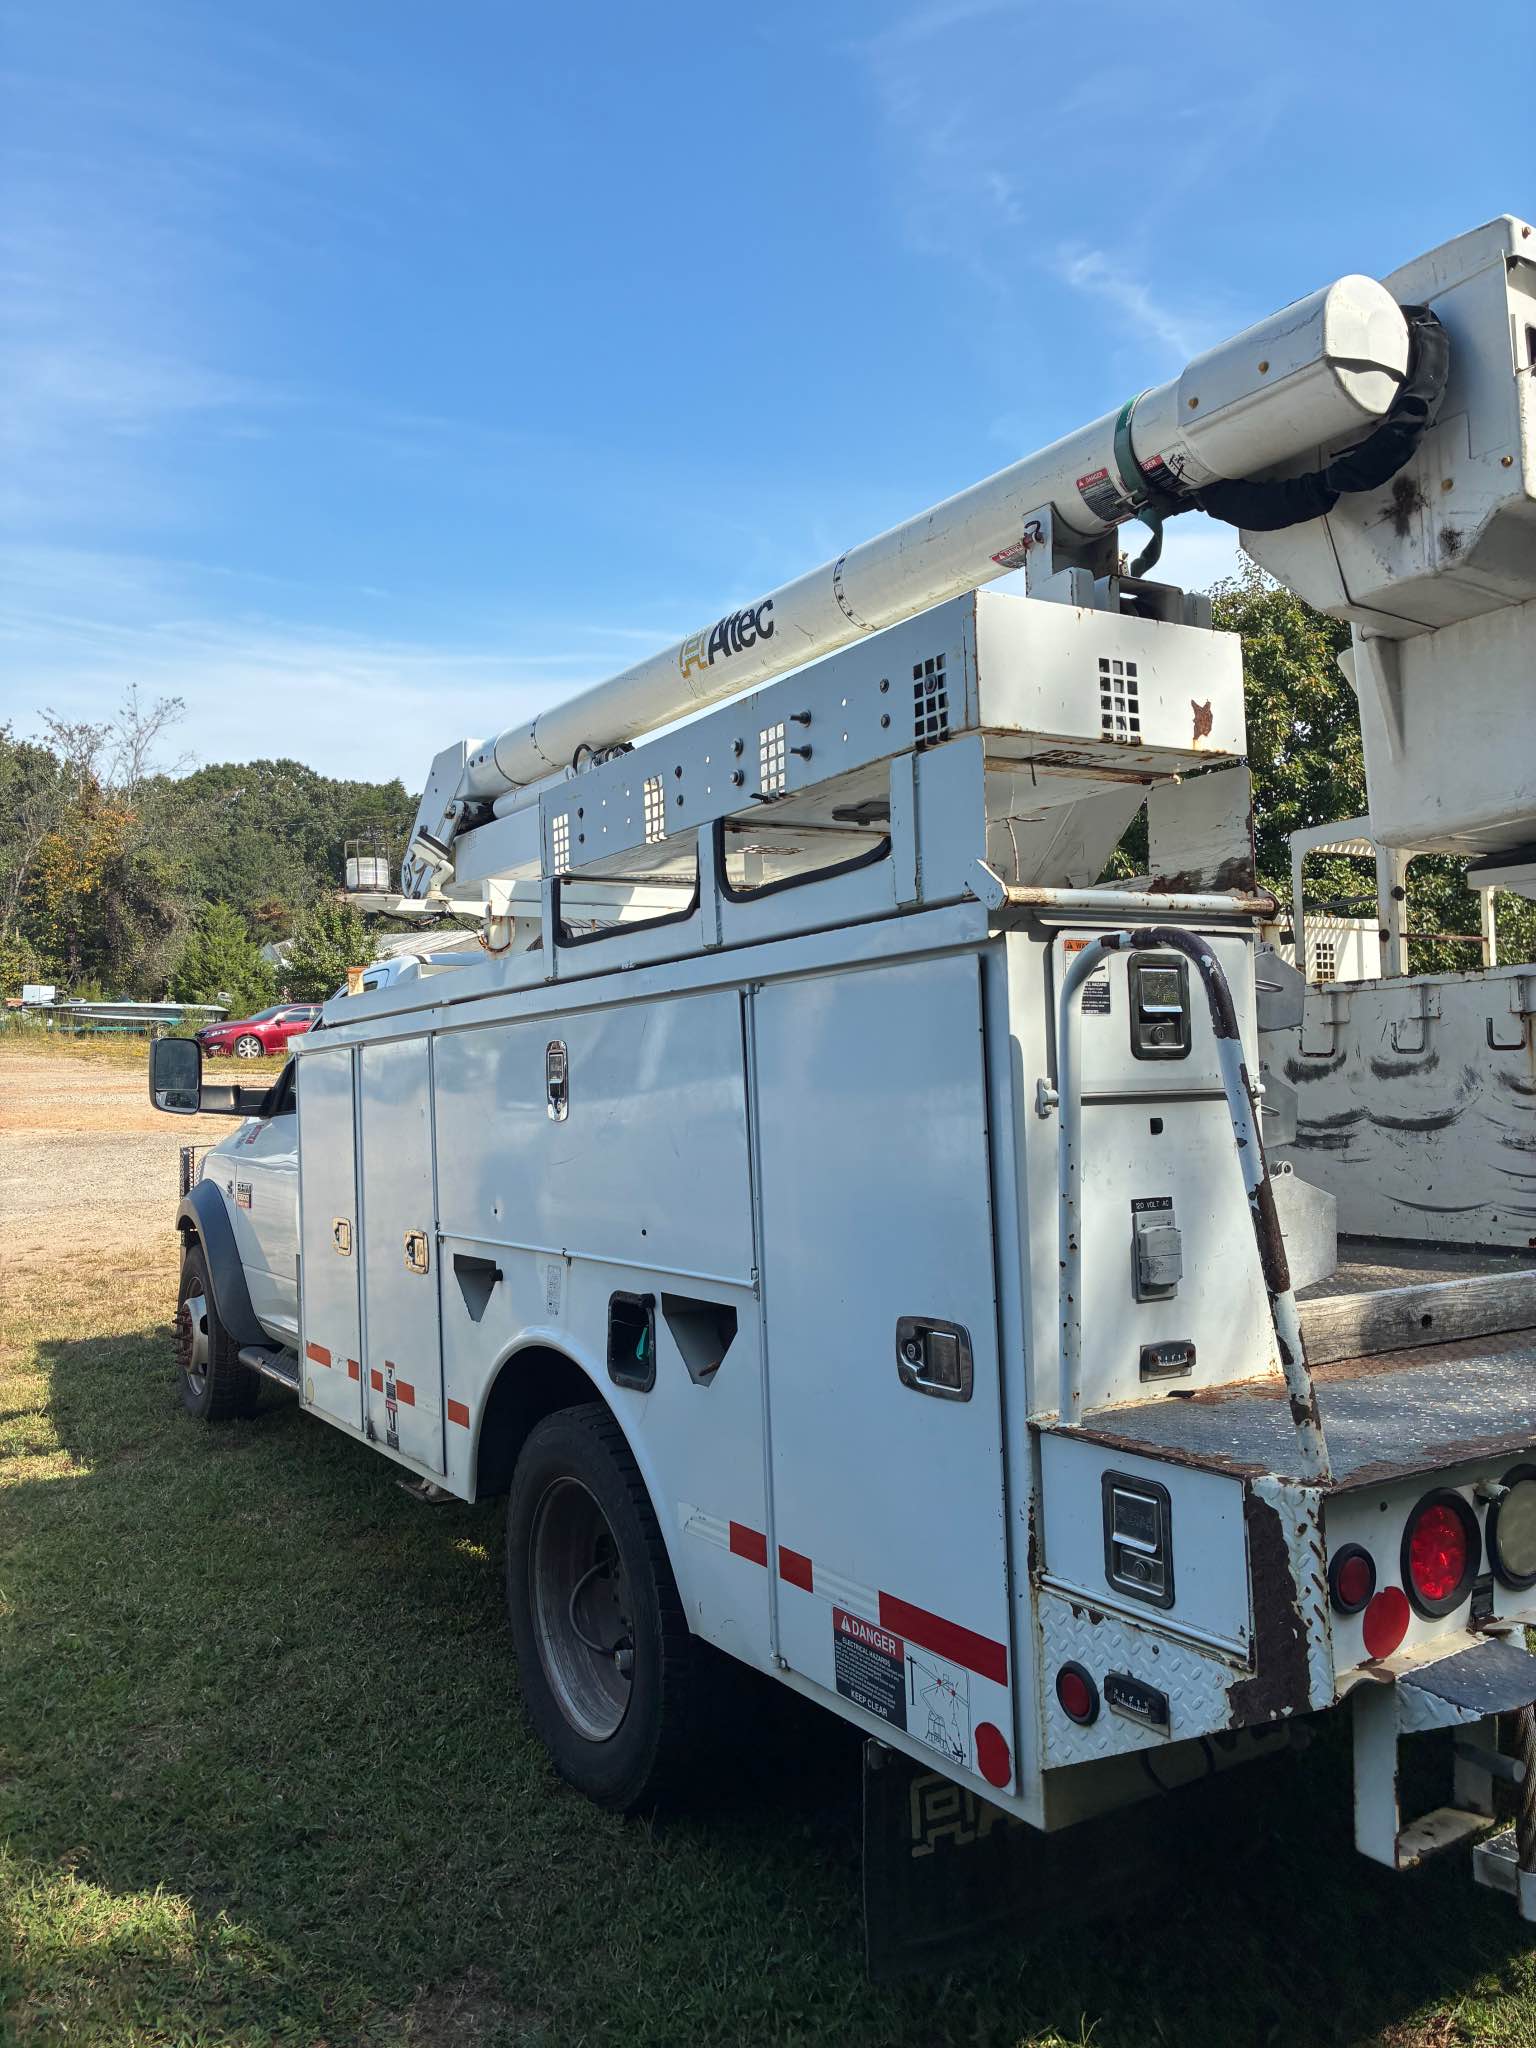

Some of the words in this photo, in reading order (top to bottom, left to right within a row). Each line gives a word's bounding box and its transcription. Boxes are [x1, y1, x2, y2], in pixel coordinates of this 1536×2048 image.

[1085, 472, 1104, 484] DANGER
[1141, 459, 1157, 471] GER
[708, 599, 774, 665] Altec
[1146, 1200, 1160, 1209] VOLT
[842, 1637, 868, 1656] ELECTRICAL
[868, 1648, 891, 1667] HAZARDS
[852, 1620, 896, 1656] DANGER
[850, 1688, 867, 1704] KEEP
[867, 1699, 888, 1718] CLEAR
